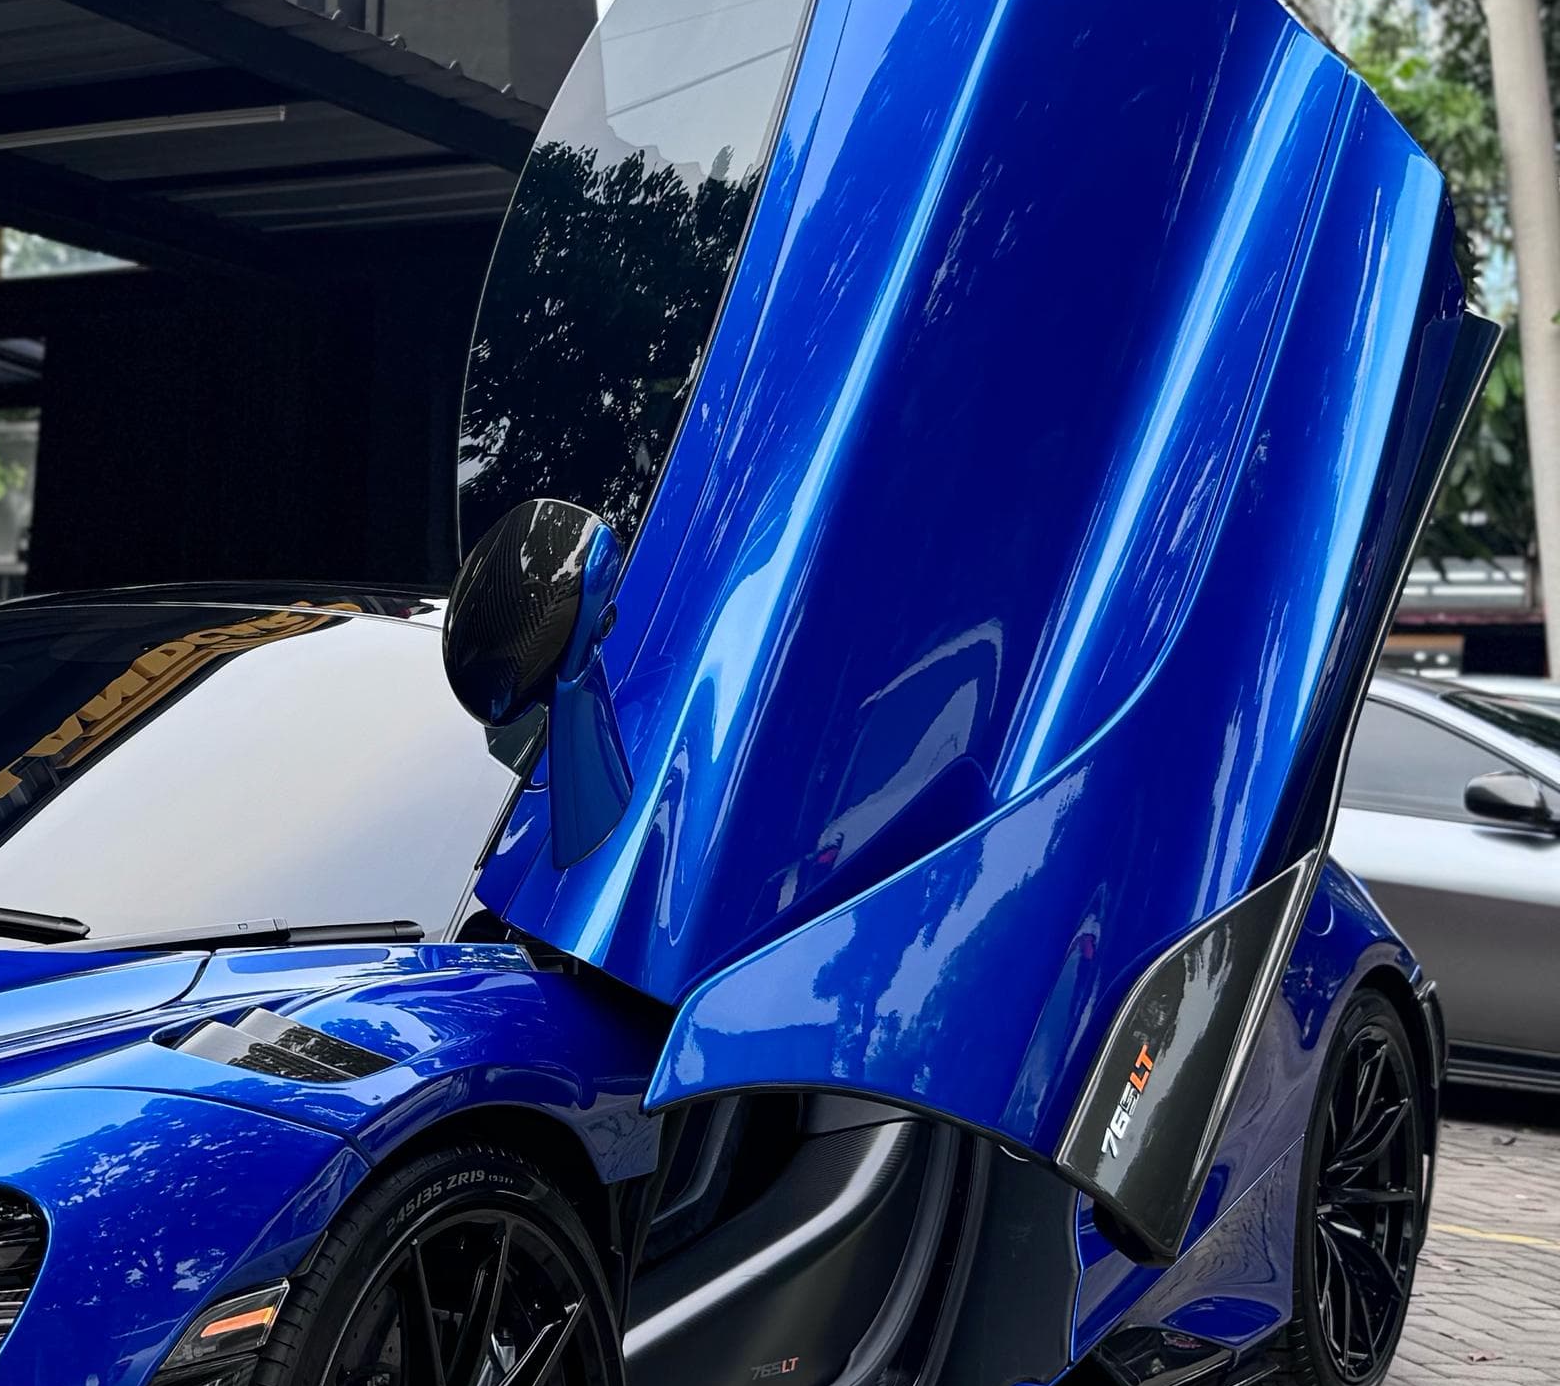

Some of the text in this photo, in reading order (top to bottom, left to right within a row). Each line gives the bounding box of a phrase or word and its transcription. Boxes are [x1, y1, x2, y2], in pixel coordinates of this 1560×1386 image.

[1100, 1043, 1154, 1159] 765LT
[385, 1180, 444, 1238] 245/35
[445, 1169, 486, 1191] ZR19
[751, 1356, 800, 1381] 765LT
